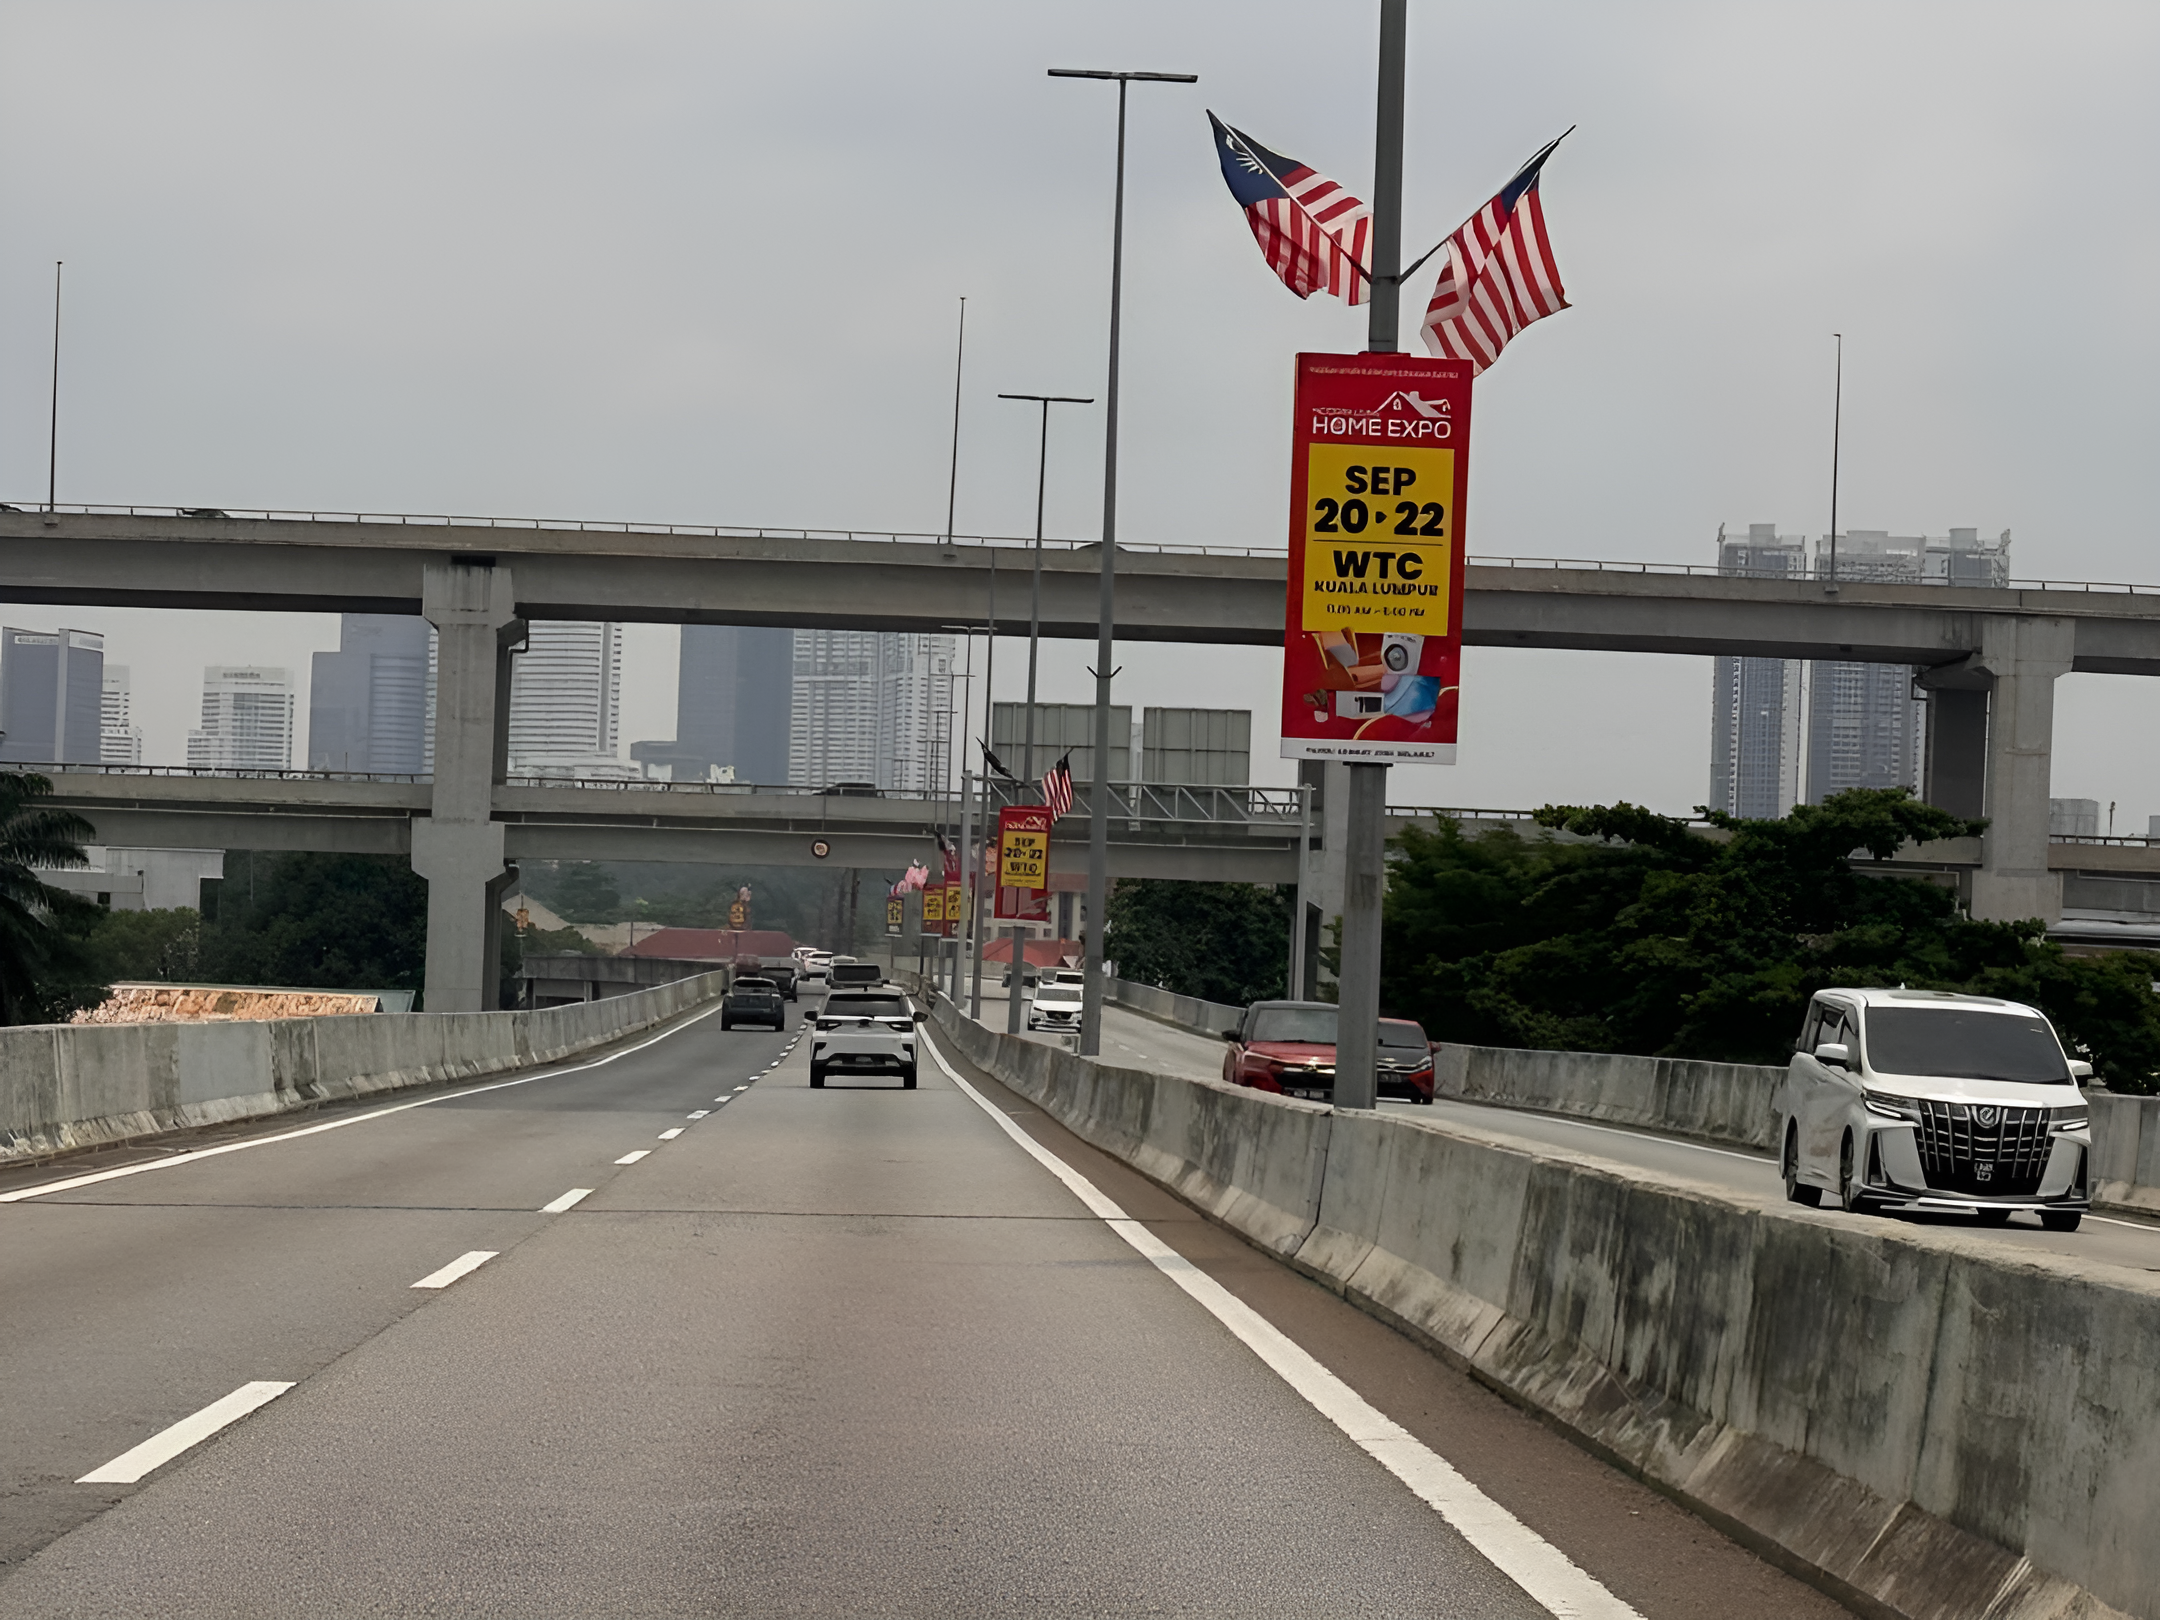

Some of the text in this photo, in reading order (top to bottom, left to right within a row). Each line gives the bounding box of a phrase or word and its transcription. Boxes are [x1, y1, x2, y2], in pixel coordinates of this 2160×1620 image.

[1312, 415, 1451, 439] HOME EXPO
[1345, 465, 1417, 496] SEP
[1314, 497, 1444, 537] 20 22
[1333, 550, 1424, 580] WTC
[1314, 580, 1368, 595] KUALA
